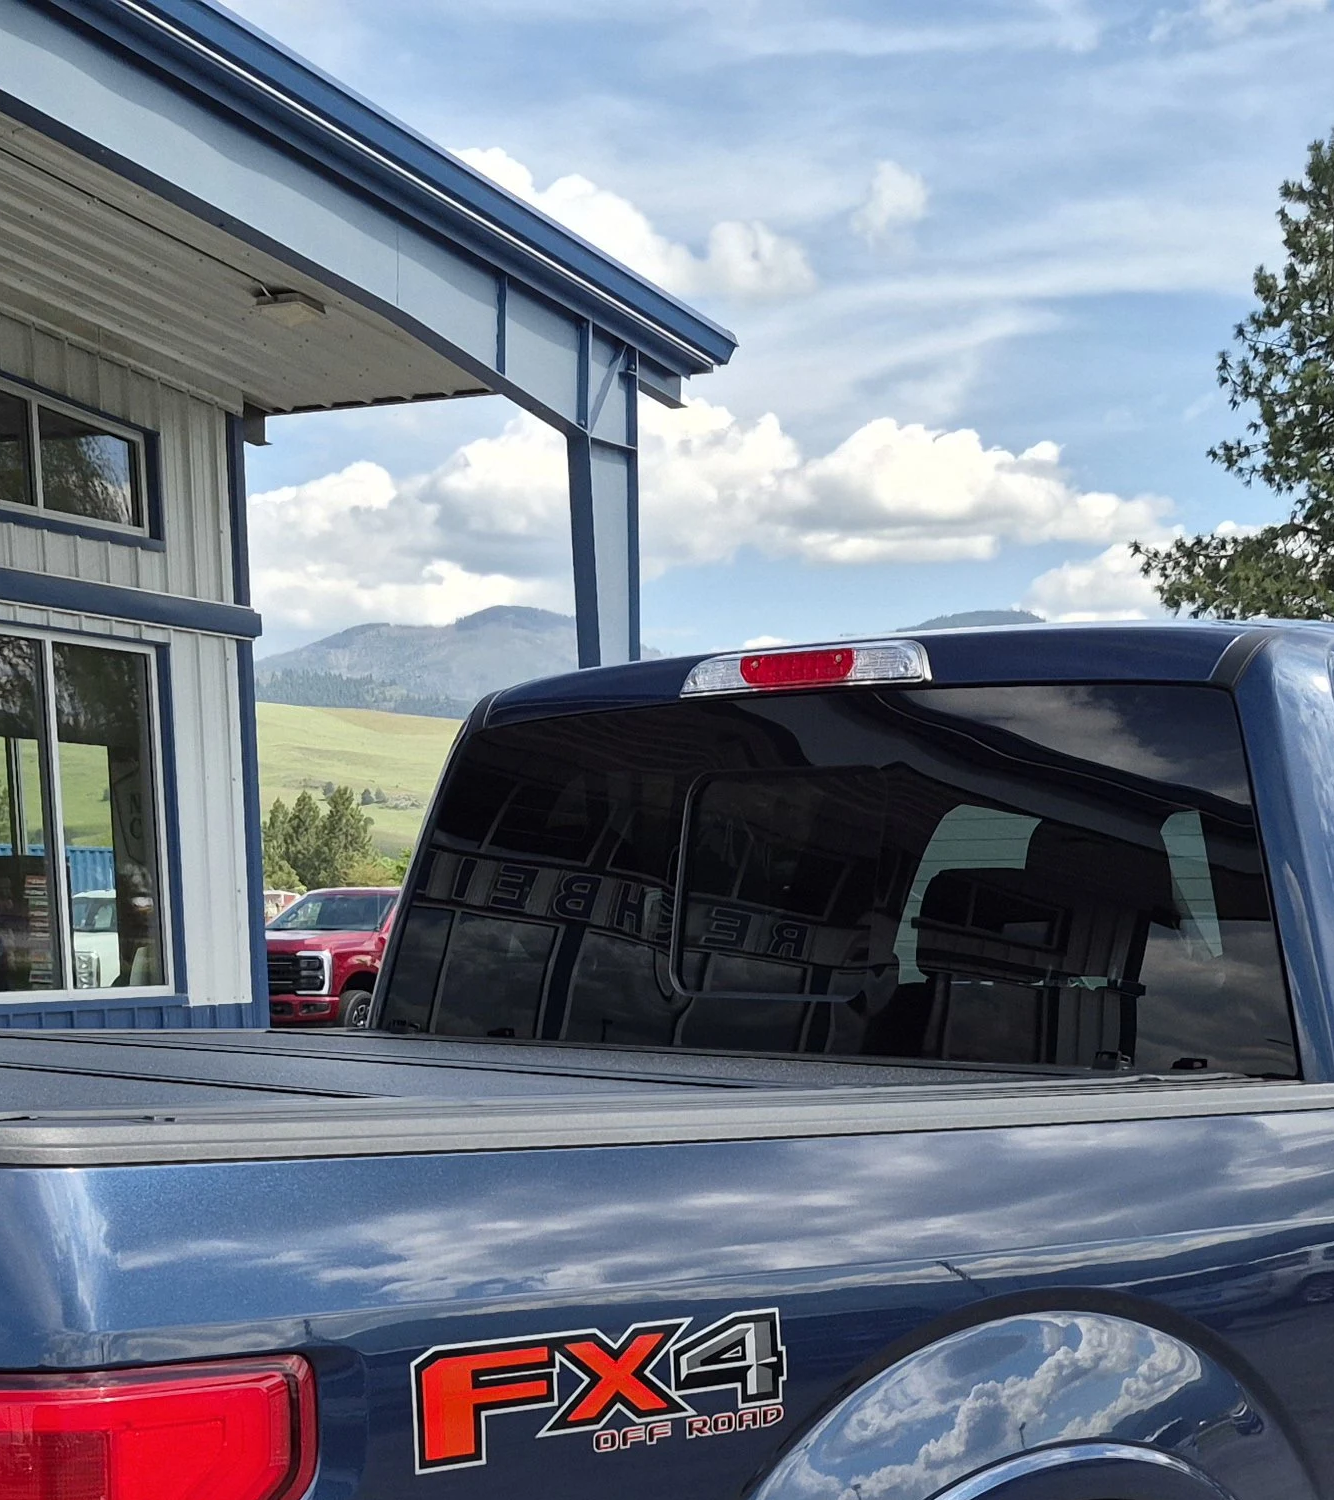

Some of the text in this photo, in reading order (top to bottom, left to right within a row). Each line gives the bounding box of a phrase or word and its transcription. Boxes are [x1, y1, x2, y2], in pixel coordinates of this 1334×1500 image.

[410, 1307, 787, 1476] FX4
[593, 1404, 785, 1453] OFF ROAD
